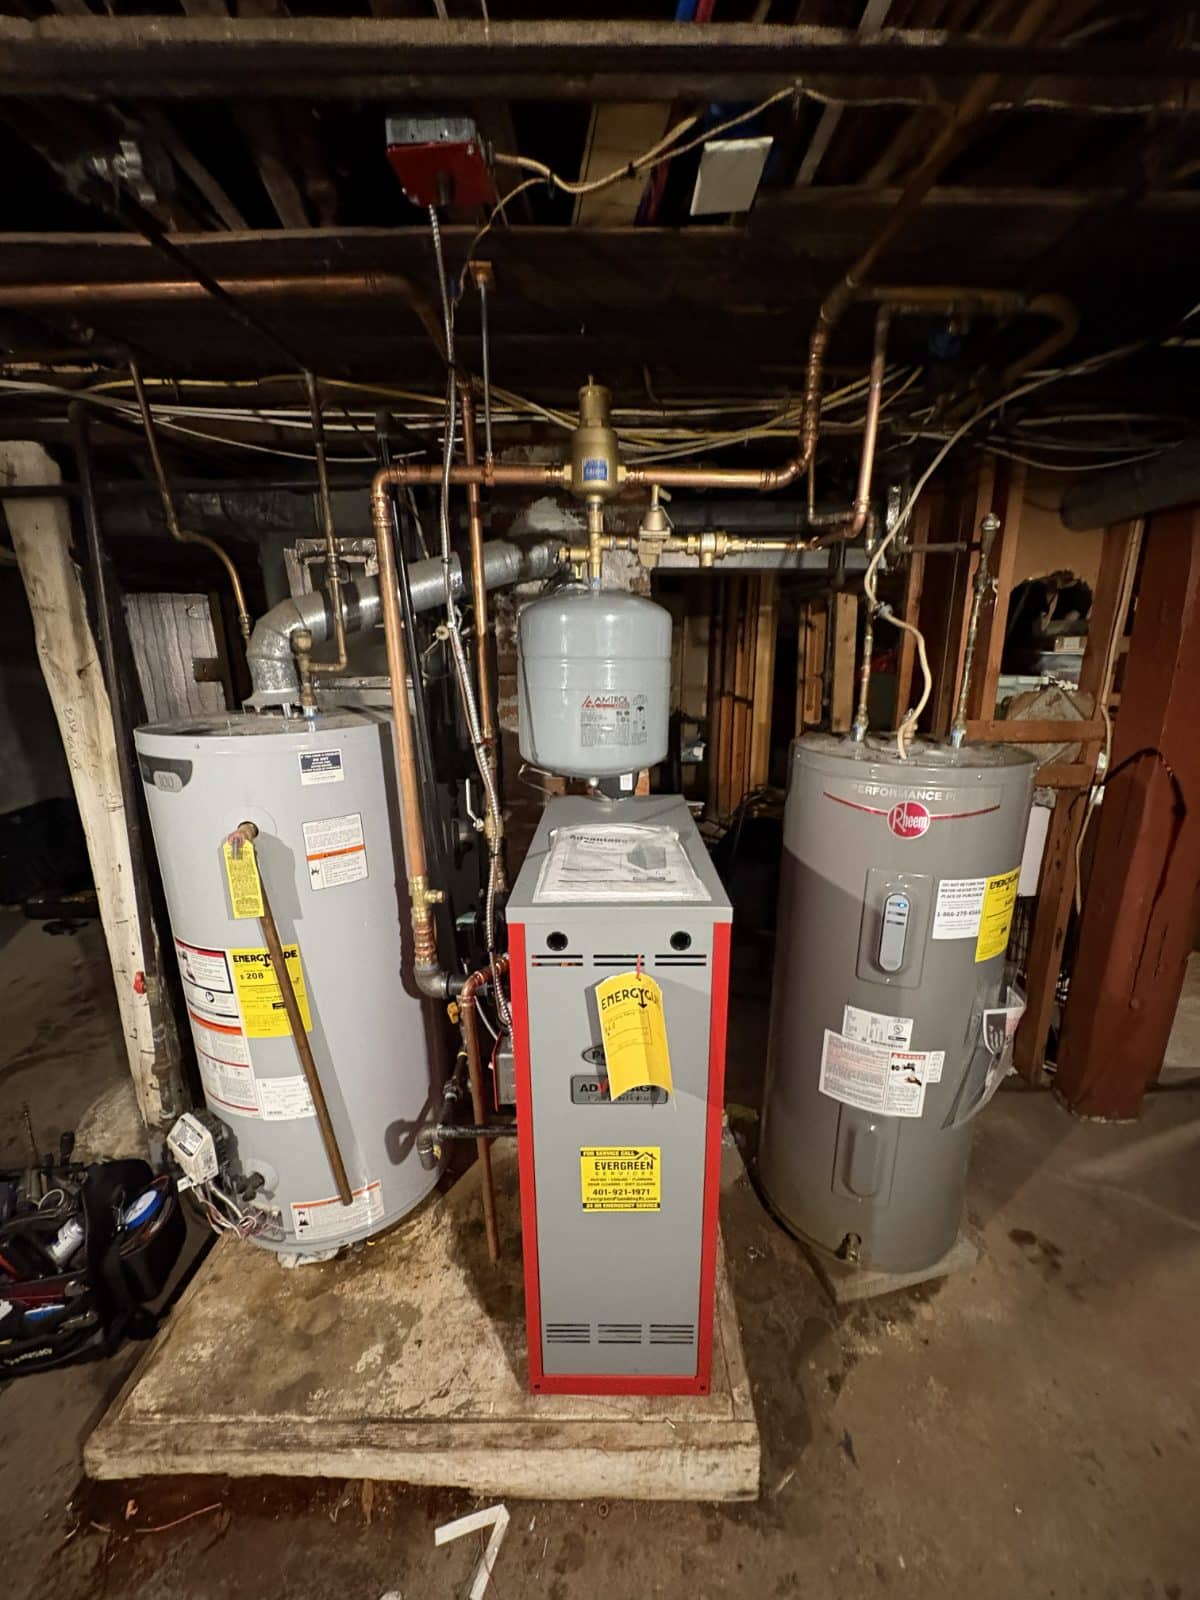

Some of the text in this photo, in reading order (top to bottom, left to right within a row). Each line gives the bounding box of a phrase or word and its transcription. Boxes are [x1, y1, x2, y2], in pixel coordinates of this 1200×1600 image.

[892, 801, 927, 832] Rheem
[594, 1160, 654, 1171] EVERGREEN
[592, 1188, 650, 1196] 401-921-1971
